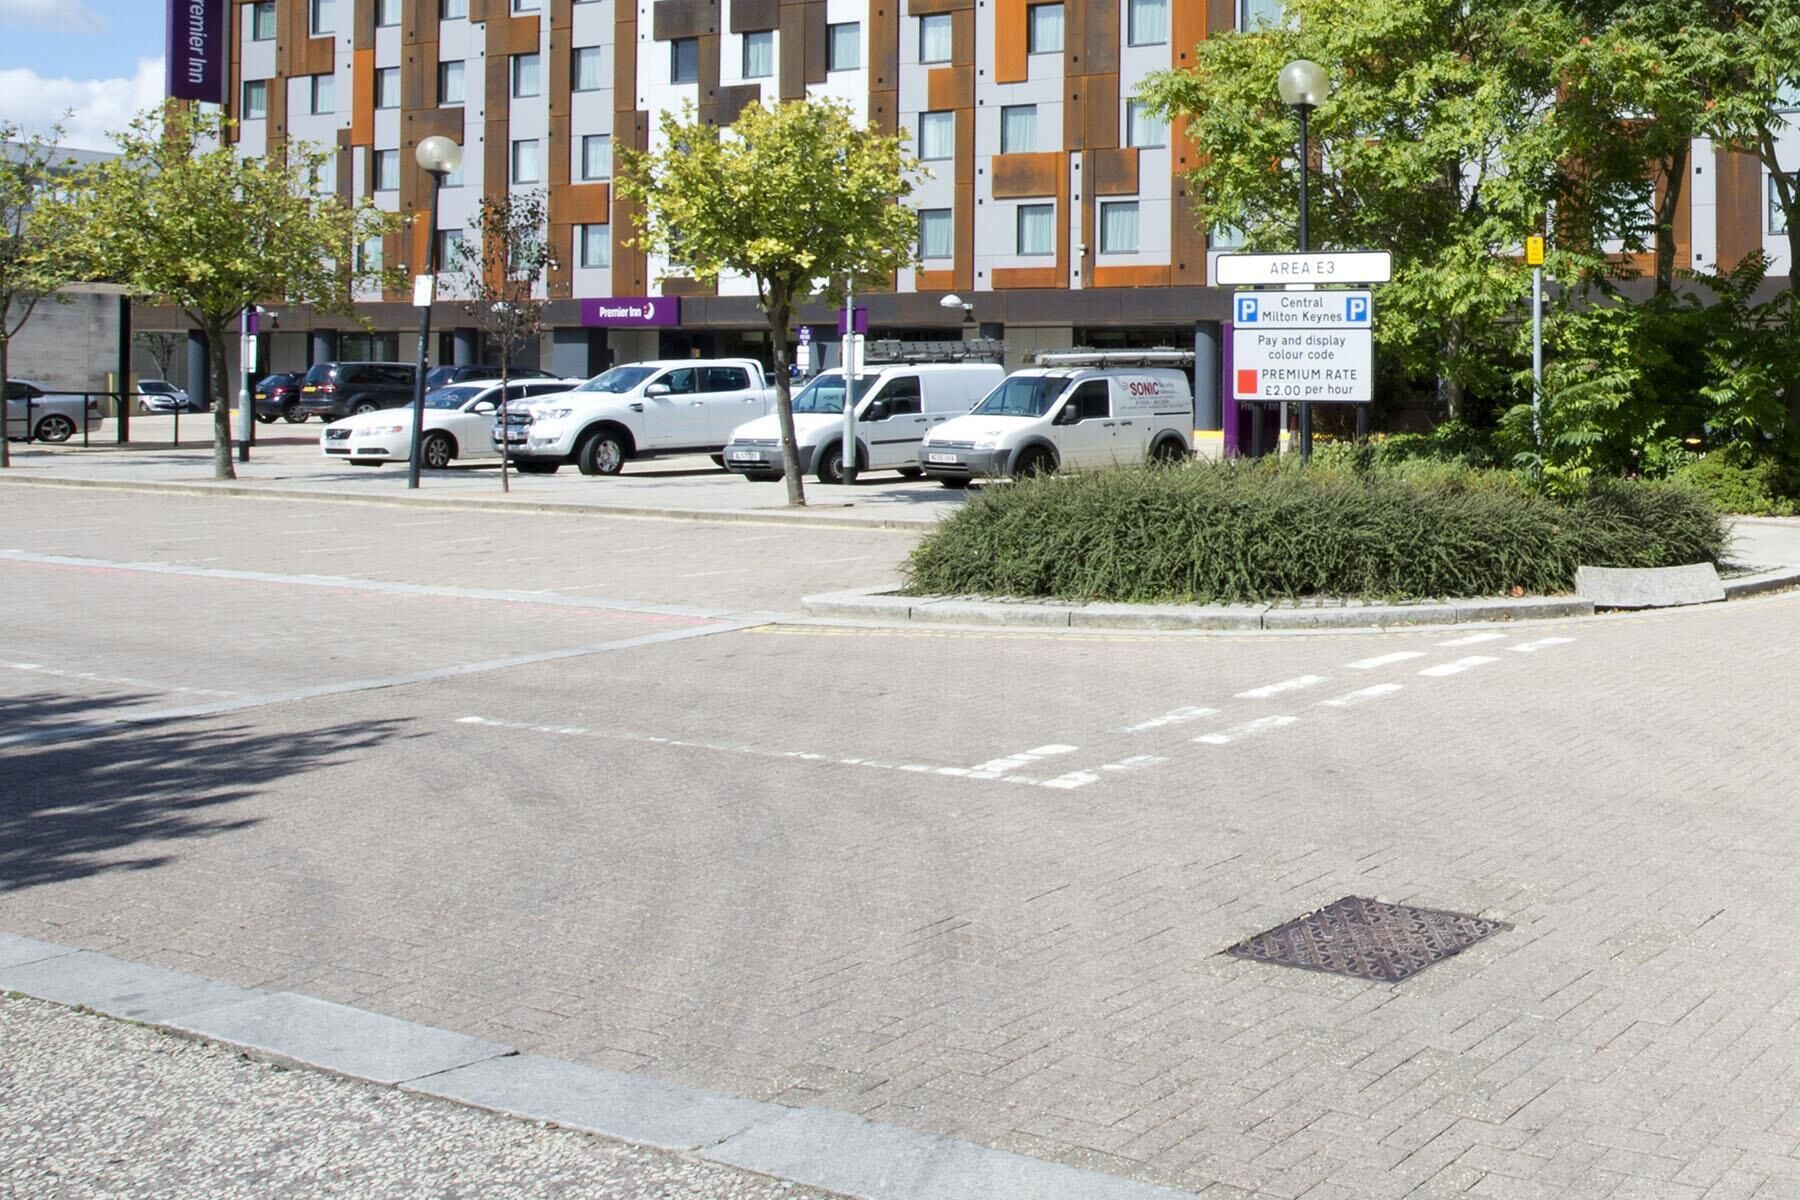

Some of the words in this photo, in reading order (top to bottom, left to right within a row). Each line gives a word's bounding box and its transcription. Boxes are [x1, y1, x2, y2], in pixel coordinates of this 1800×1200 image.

[188, 57, 207, 83] Inn
[1270, 261, 1310, 275] AREA
[1317, 261, 1335, 274] E3
[1281, 296, 1323, 308] Central
[599, 306, 629, 318] Premier
[629, 306, 642, 317] Inn
[1262, 311, 1298, 322] Milton
[1302, 311, 1342, 323] Keynes
[1258, 335, 1278, 347] Pay
[1281, 335, 1301, 346] and
[1306, 335, 1346, 347] display
[1268, 349, 1303, 360] colour
[1308, 349, 1334, 360] code
[1262, 369, 1321, 380] PREMIUM
[1326, 369, 1358, 380] RATE
[1130, 382, 1160, 396] SONIC
[1265, 385, 1301, 396] £2.00
[1305, 386, 1324, 397] per
[1328, 384, 1353, 395] hour
